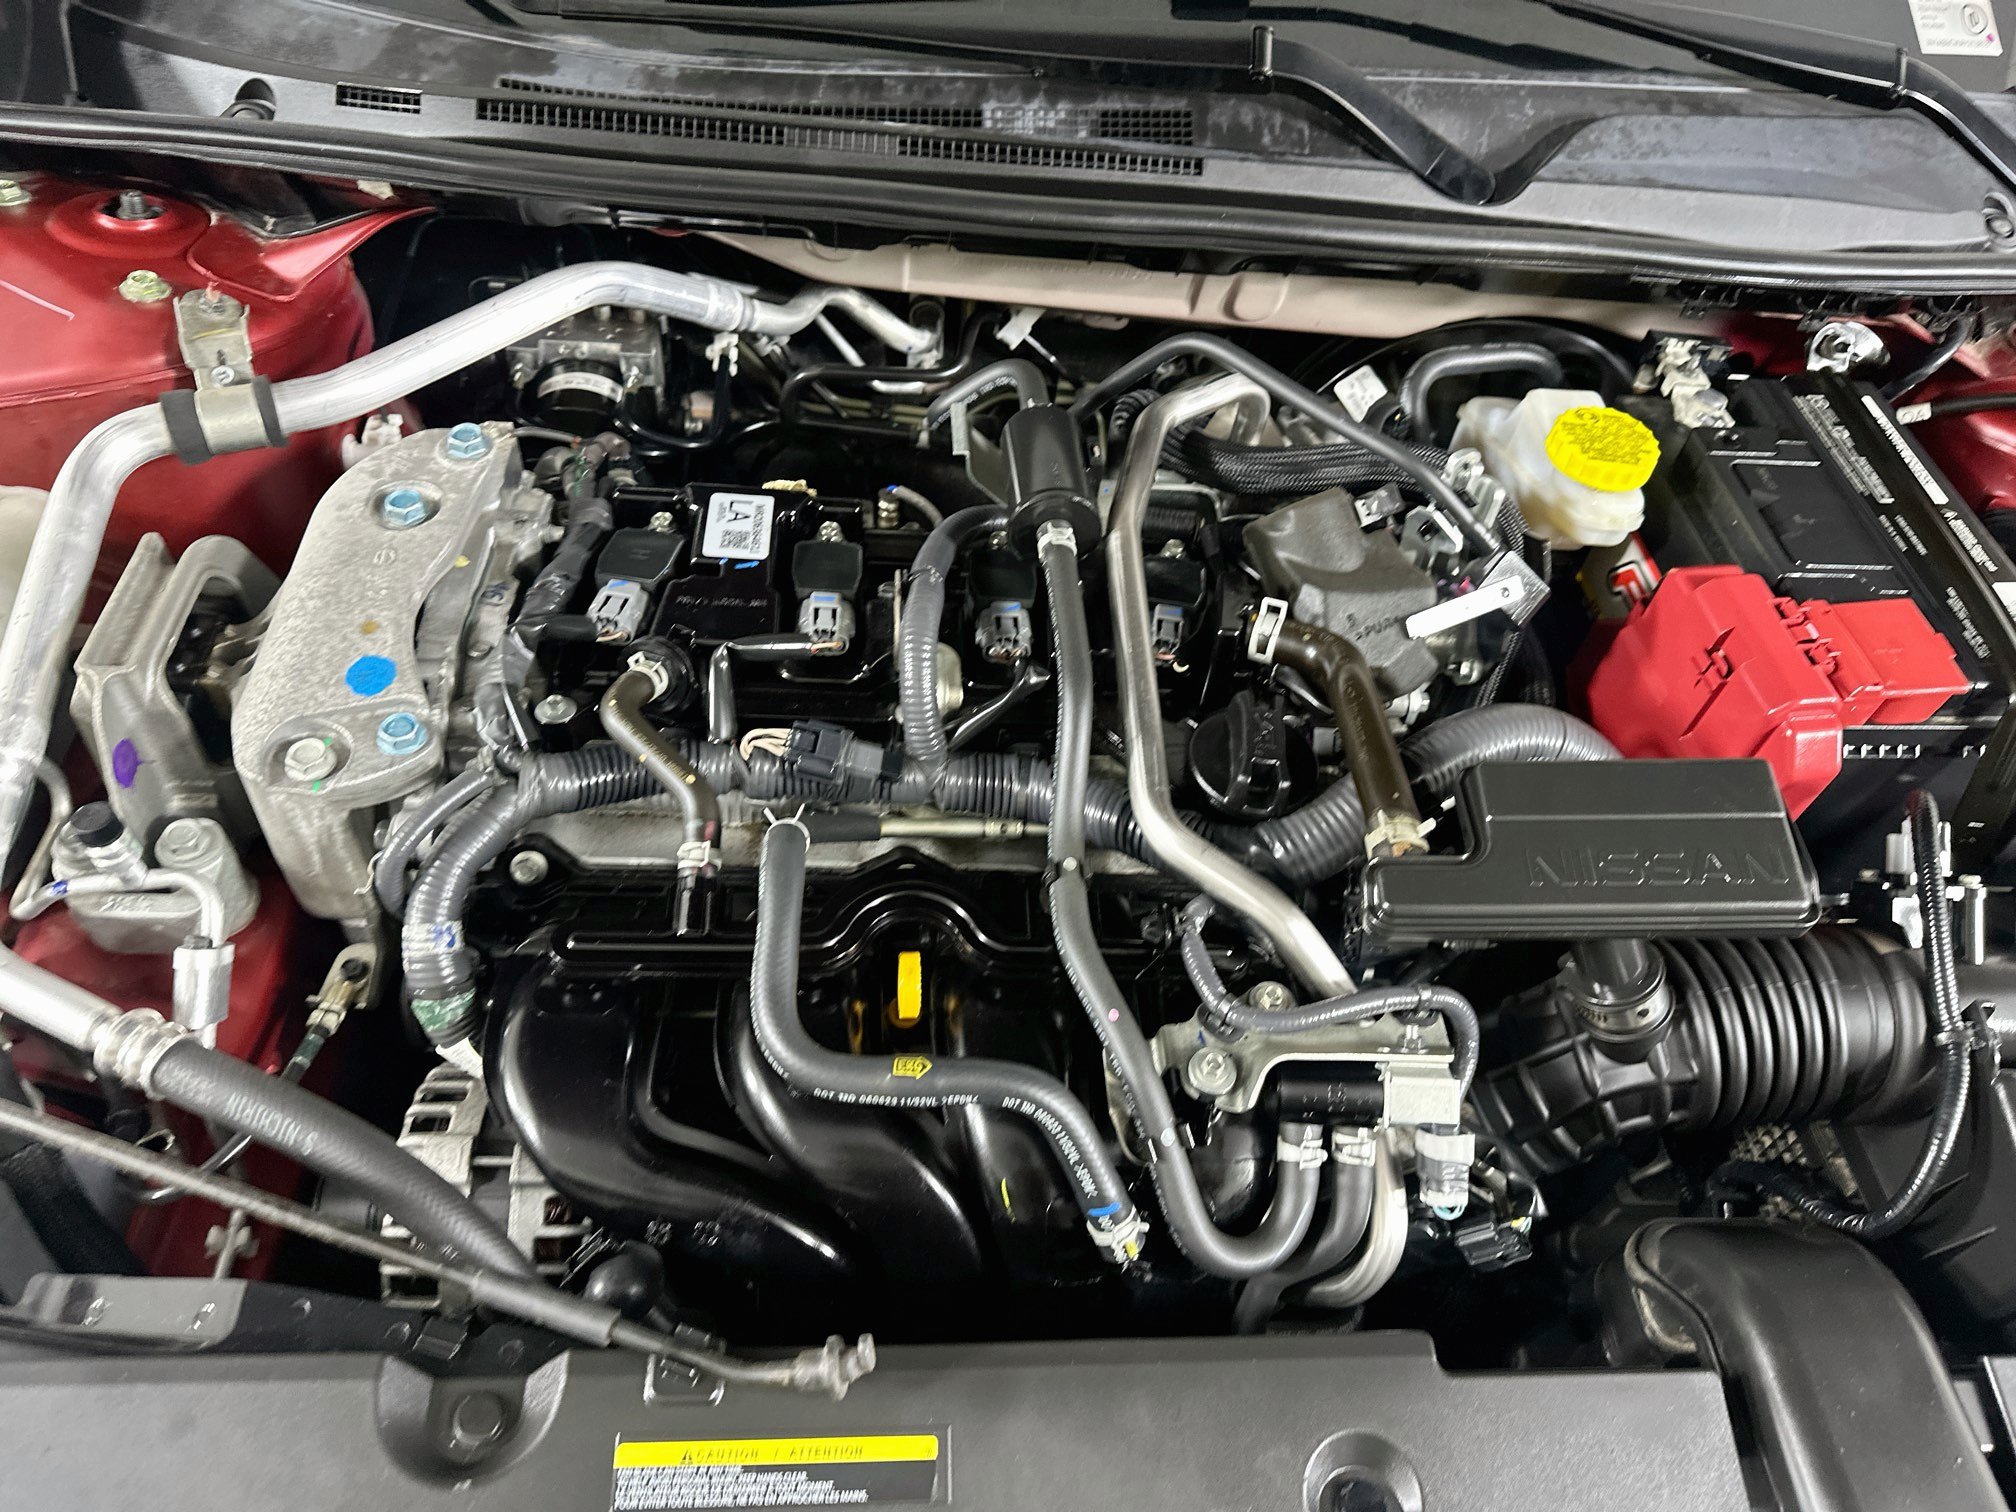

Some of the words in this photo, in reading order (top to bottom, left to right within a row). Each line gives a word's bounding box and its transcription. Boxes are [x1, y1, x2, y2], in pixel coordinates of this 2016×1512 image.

[1525, 848, 1790, 888] NISSAN
[696, 1448, 759, 1463] CAUTION
[788, 1445, 864, 1461] ATTENTION
